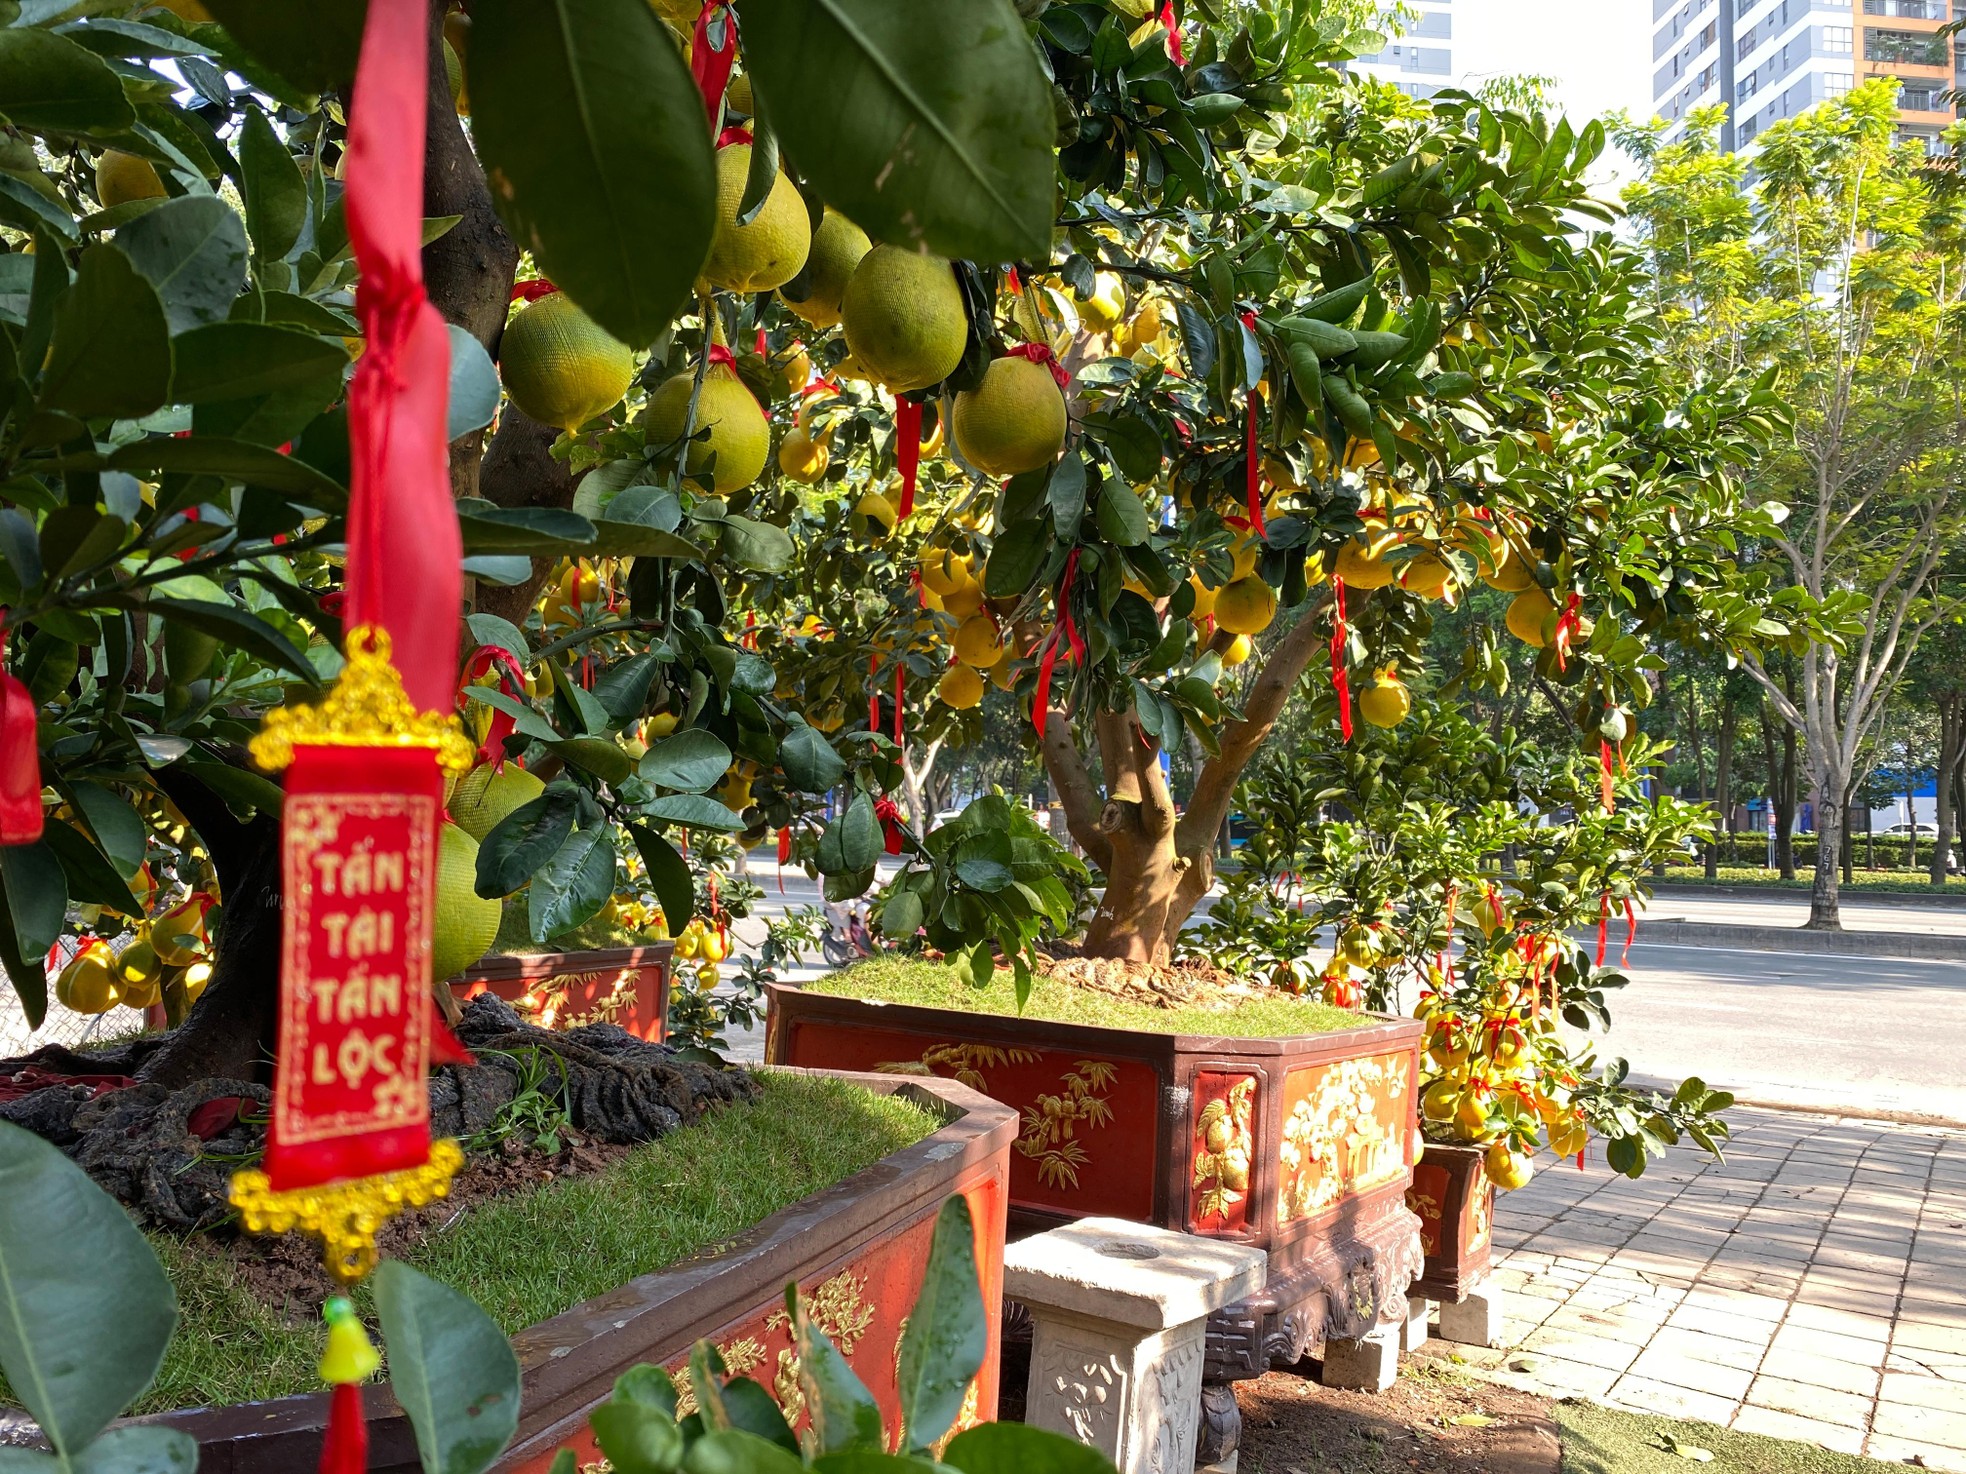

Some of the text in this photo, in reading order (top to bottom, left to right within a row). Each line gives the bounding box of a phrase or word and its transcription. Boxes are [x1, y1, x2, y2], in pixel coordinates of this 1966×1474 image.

[313, 836, 404, 898] TẤN
[1823, 846, 1832, 870] 767
[311, 961, 401, 1024] TẤN
[312, 1028, 397, 1089] LỘC
